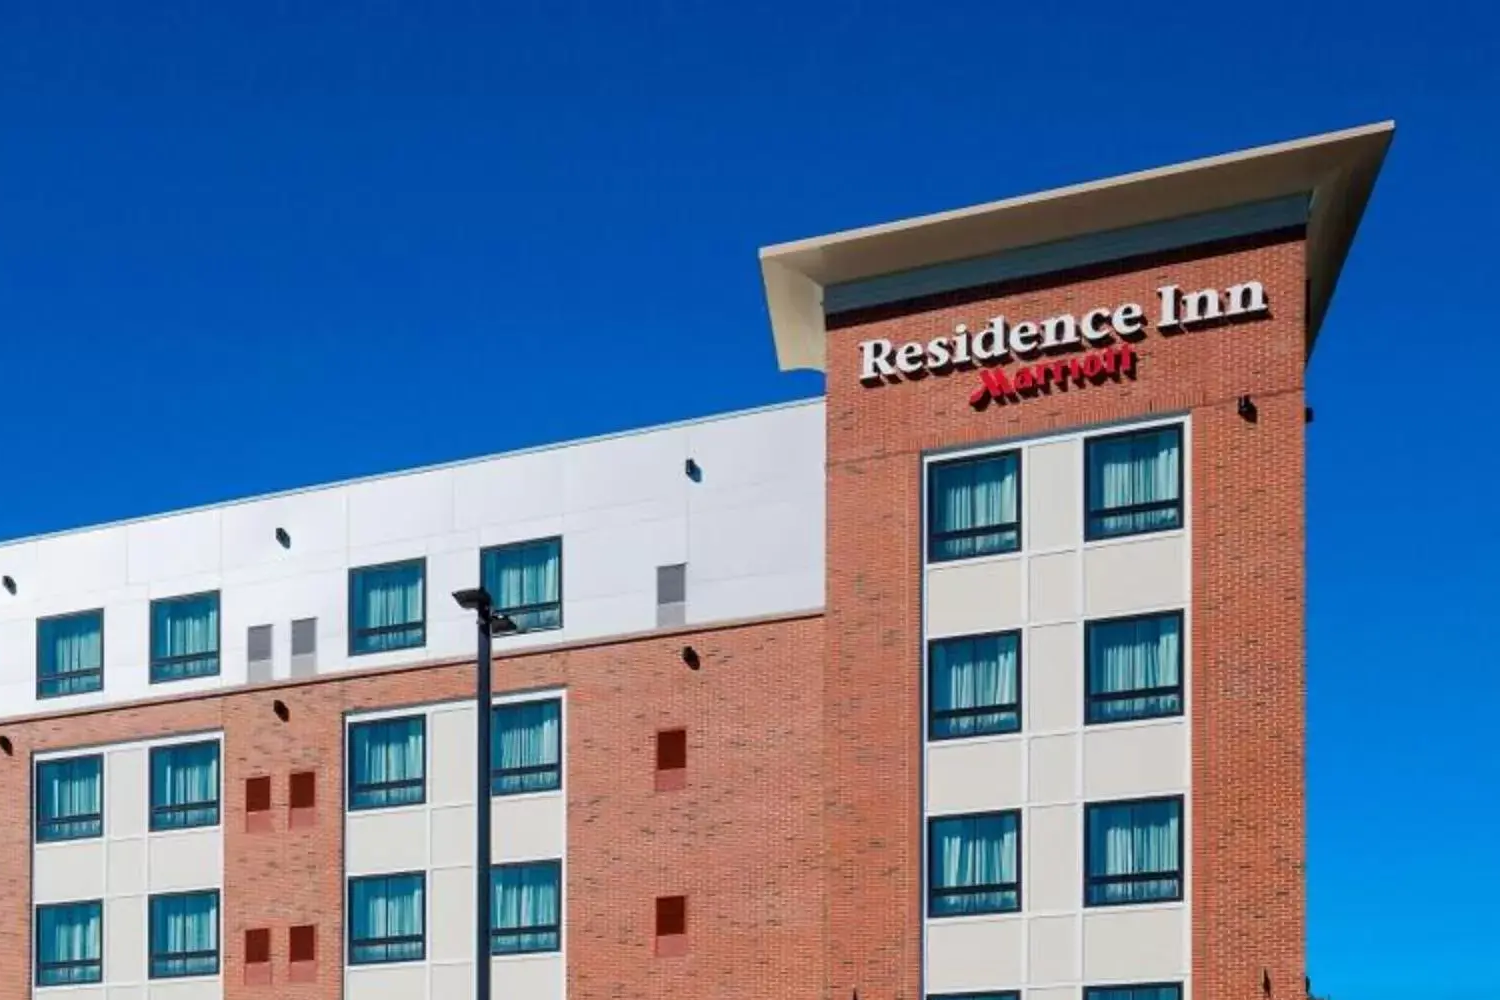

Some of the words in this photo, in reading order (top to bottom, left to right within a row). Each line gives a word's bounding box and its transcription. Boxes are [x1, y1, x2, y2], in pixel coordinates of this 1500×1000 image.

[858, 301, 1143, 380] Residence
[1156, 279, 1269, 327] Inn
[969, 342, 1135, 404] Marriott
